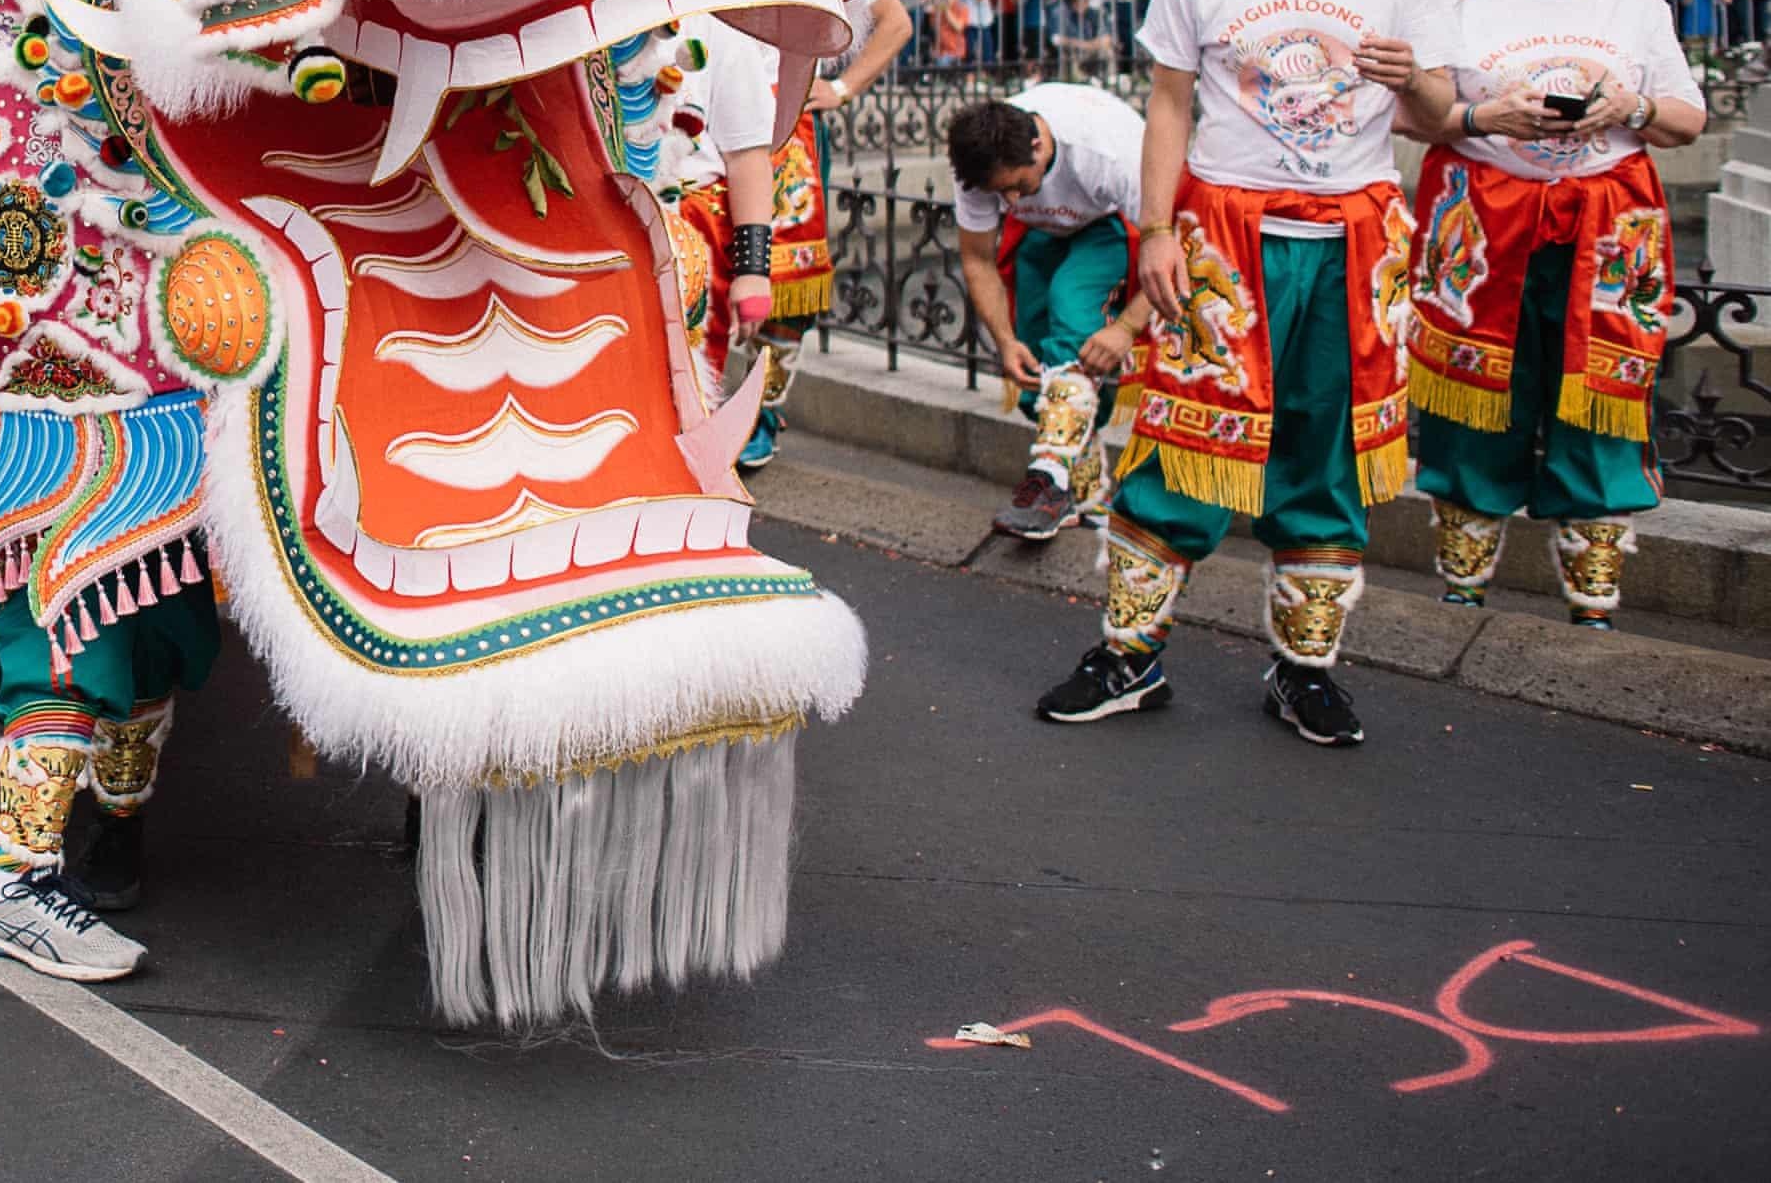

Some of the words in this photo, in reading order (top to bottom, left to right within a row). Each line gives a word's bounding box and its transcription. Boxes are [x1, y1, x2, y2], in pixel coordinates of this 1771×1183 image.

[1218, 18, 1245, 45] DAI
[1479, 49, 1505, 71] DAI
[1505, 34, 1548, 53] GUM
[1552, 33, 1618, 56] LOONG
